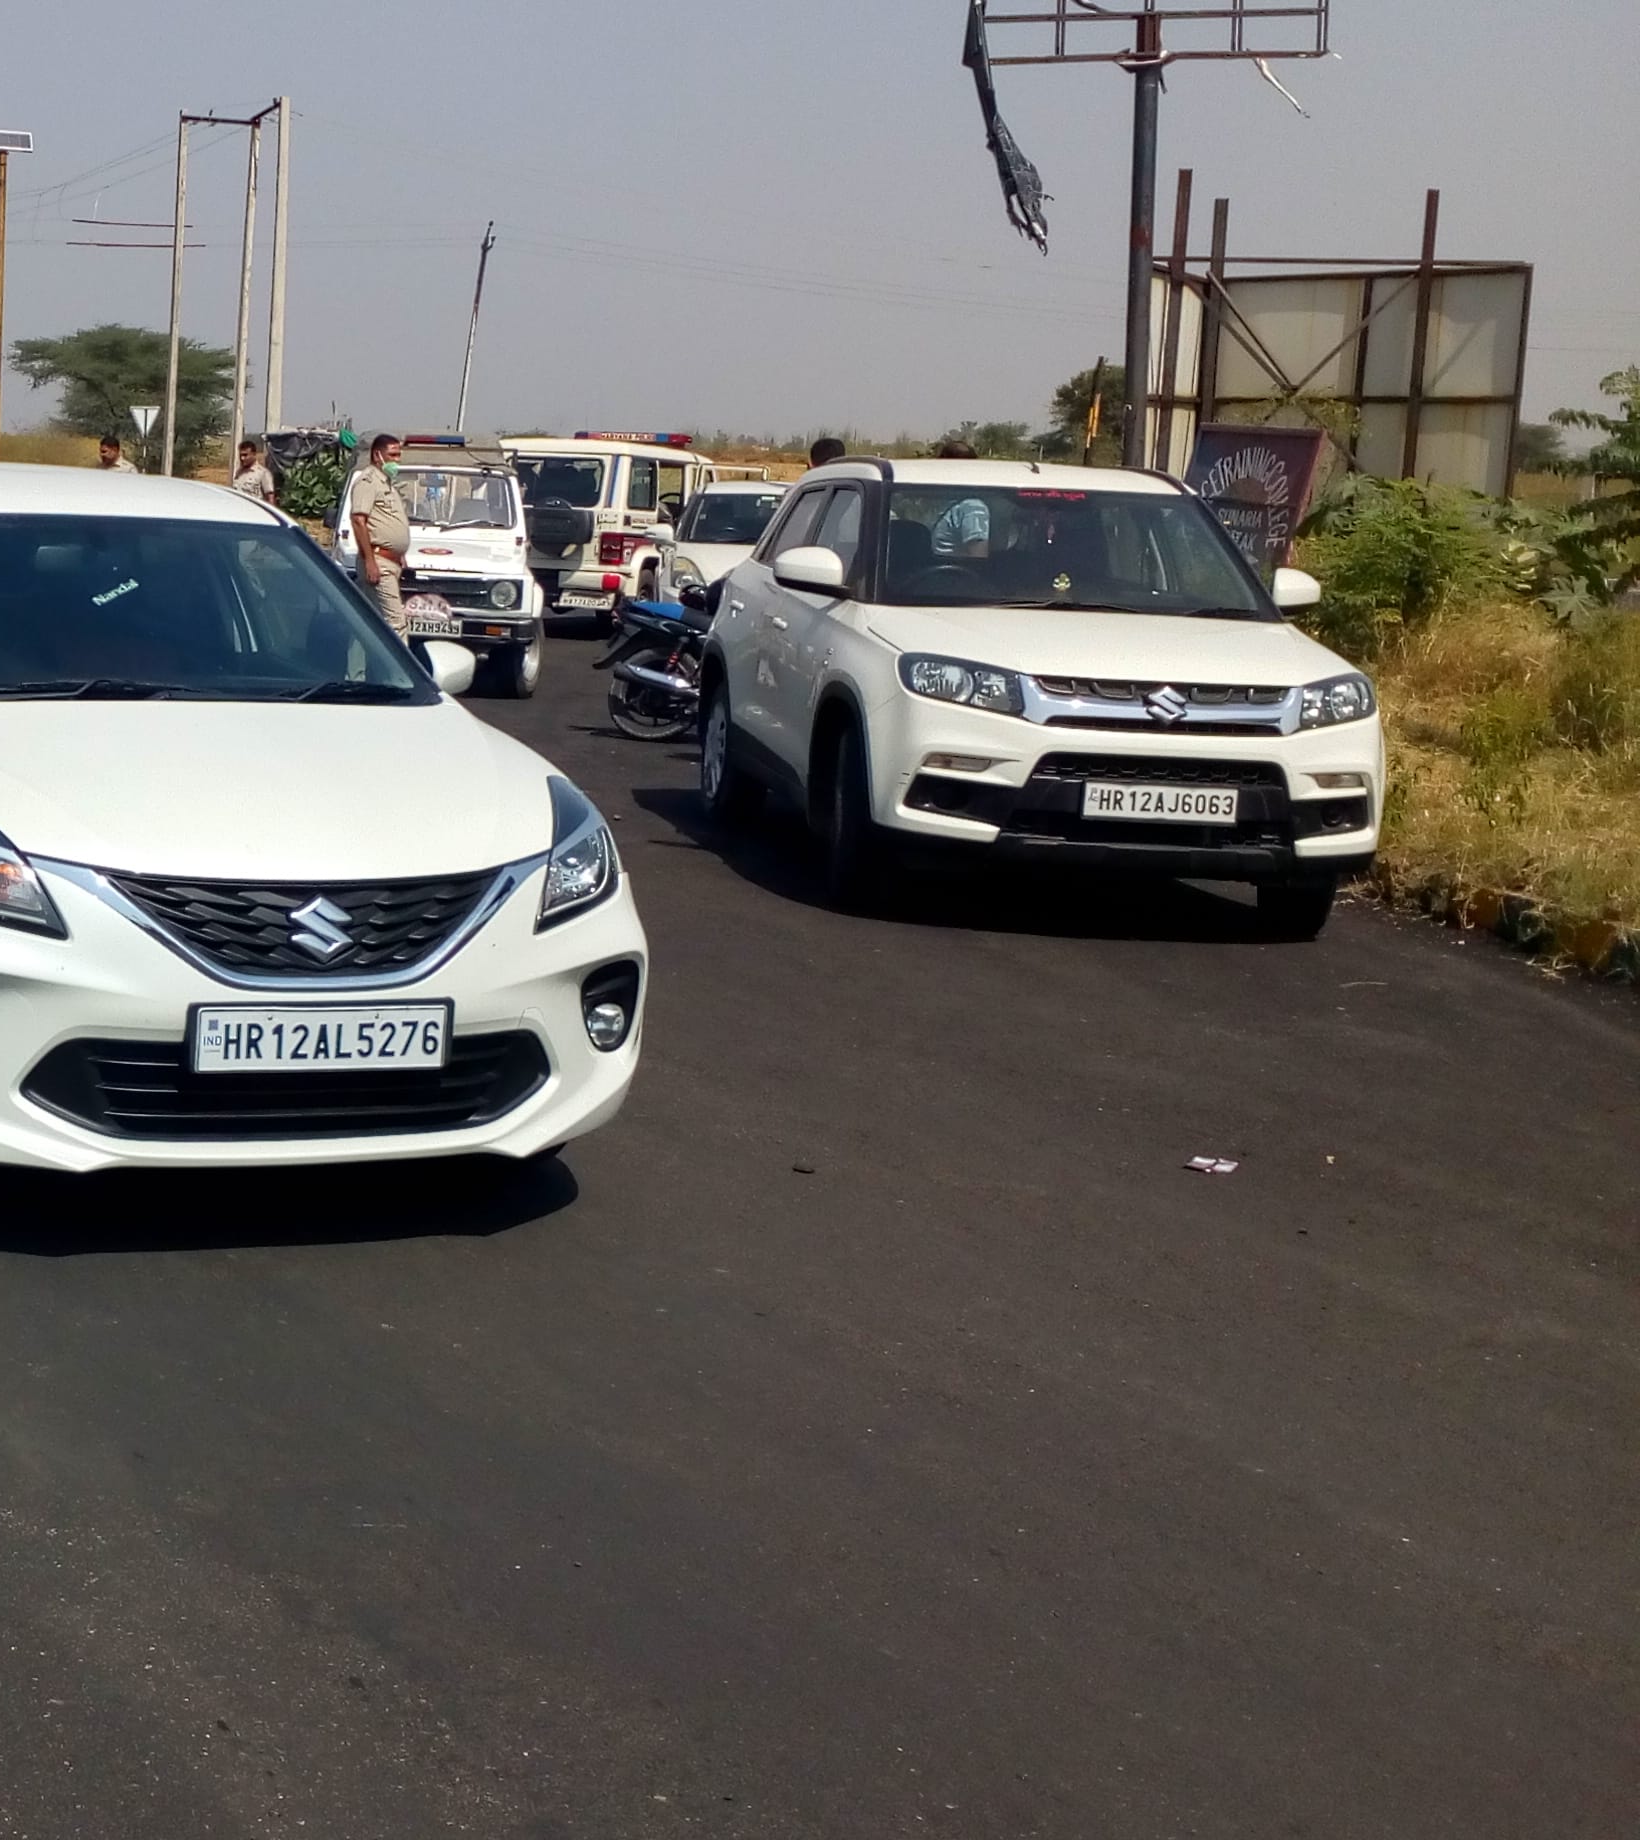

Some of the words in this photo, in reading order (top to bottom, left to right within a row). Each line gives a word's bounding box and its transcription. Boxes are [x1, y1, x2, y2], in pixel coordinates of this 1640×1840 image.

[92, 578, 139, 606] Nandal
[410, 620, 460, 634] 12AH9499
[1098, 789, 1234, 816] HR12AJ6063
[203, 1035, 222, 1047] IND
[223, 1020, 440, 1060] HR12AL5276
